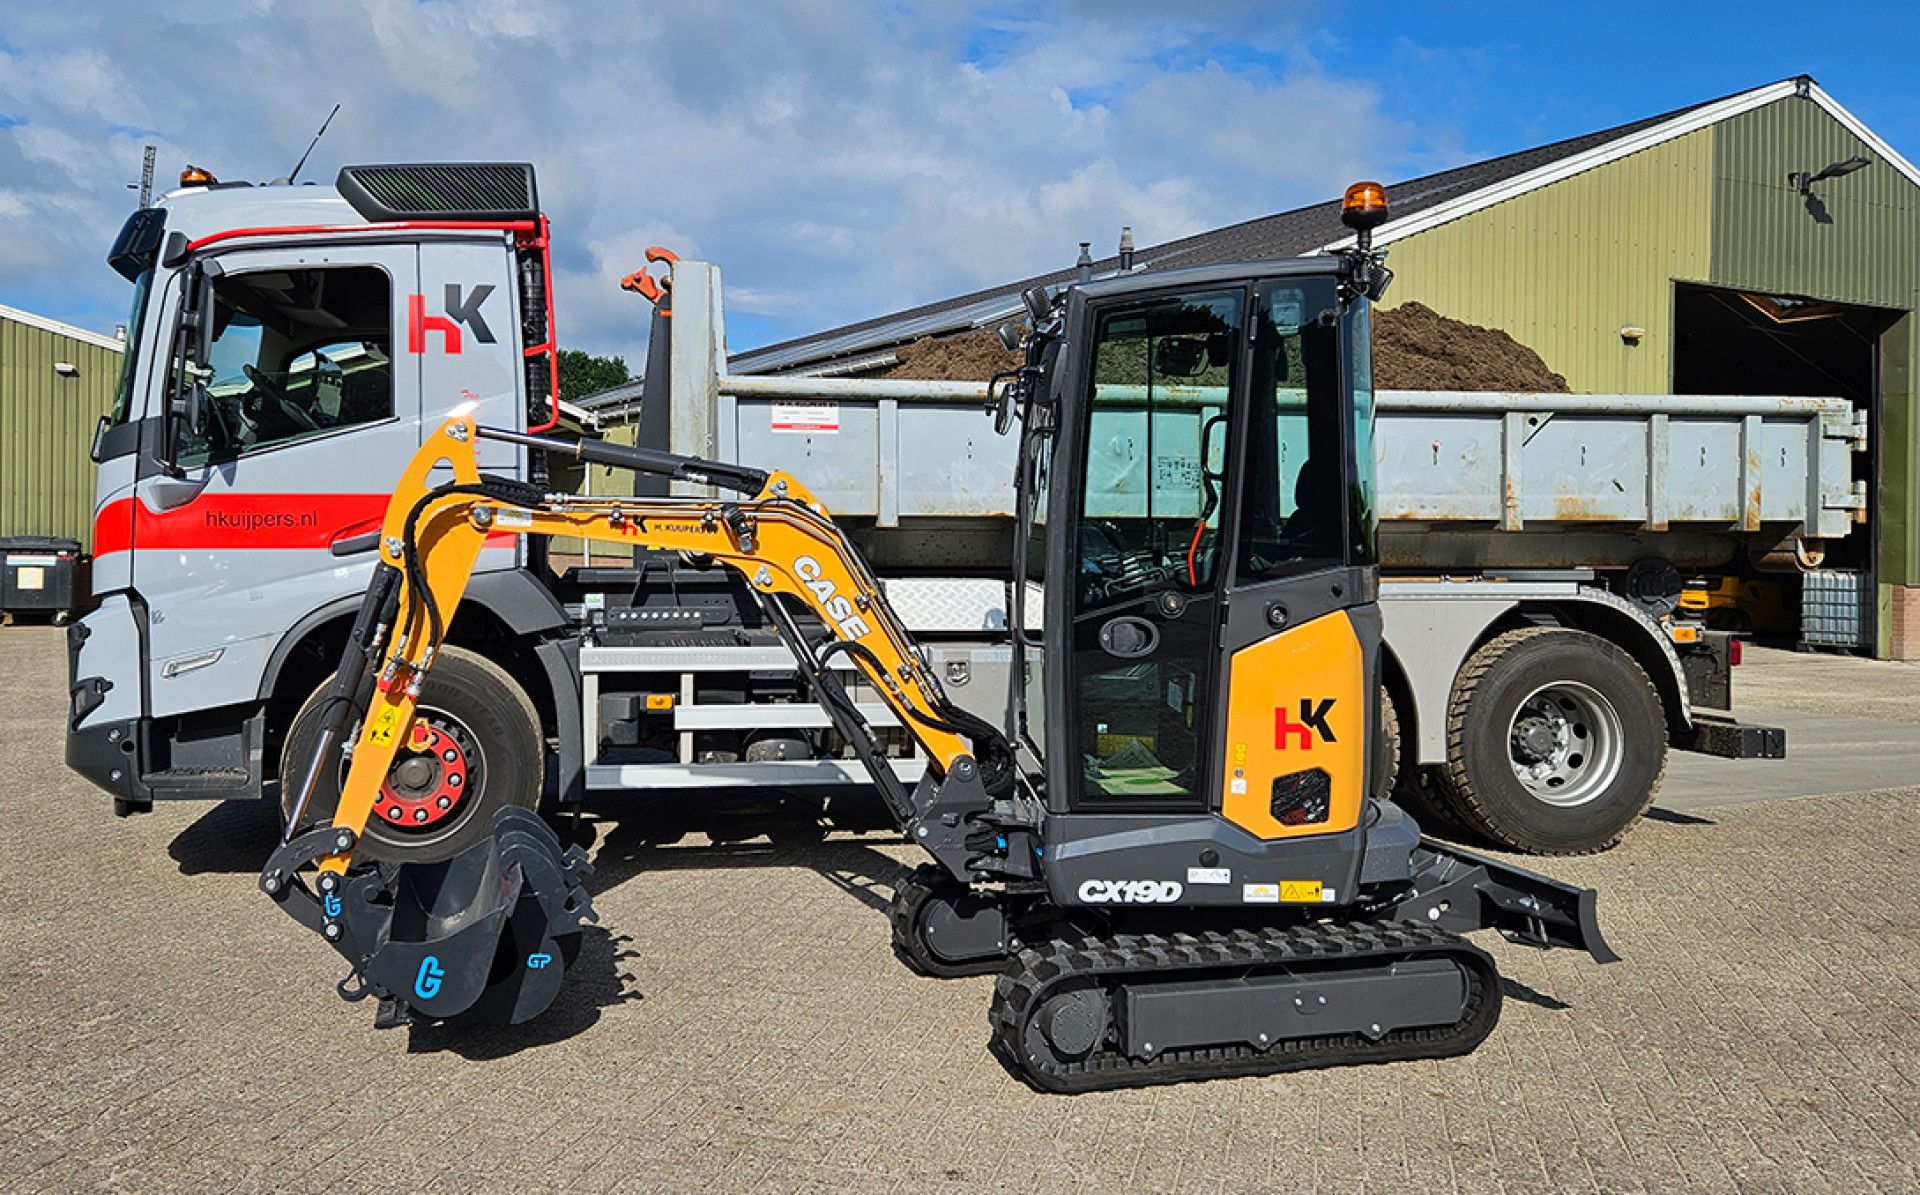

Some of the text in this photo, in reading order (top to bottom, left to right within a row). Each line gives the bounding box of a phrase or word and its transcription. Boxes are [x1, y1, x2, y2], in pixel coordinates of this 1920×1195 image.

[205, 510, 318, 531] hkuijpers.nl
[794, 555, 871, 641] CASE
[1078, 880, 1184, 903] CX19D
